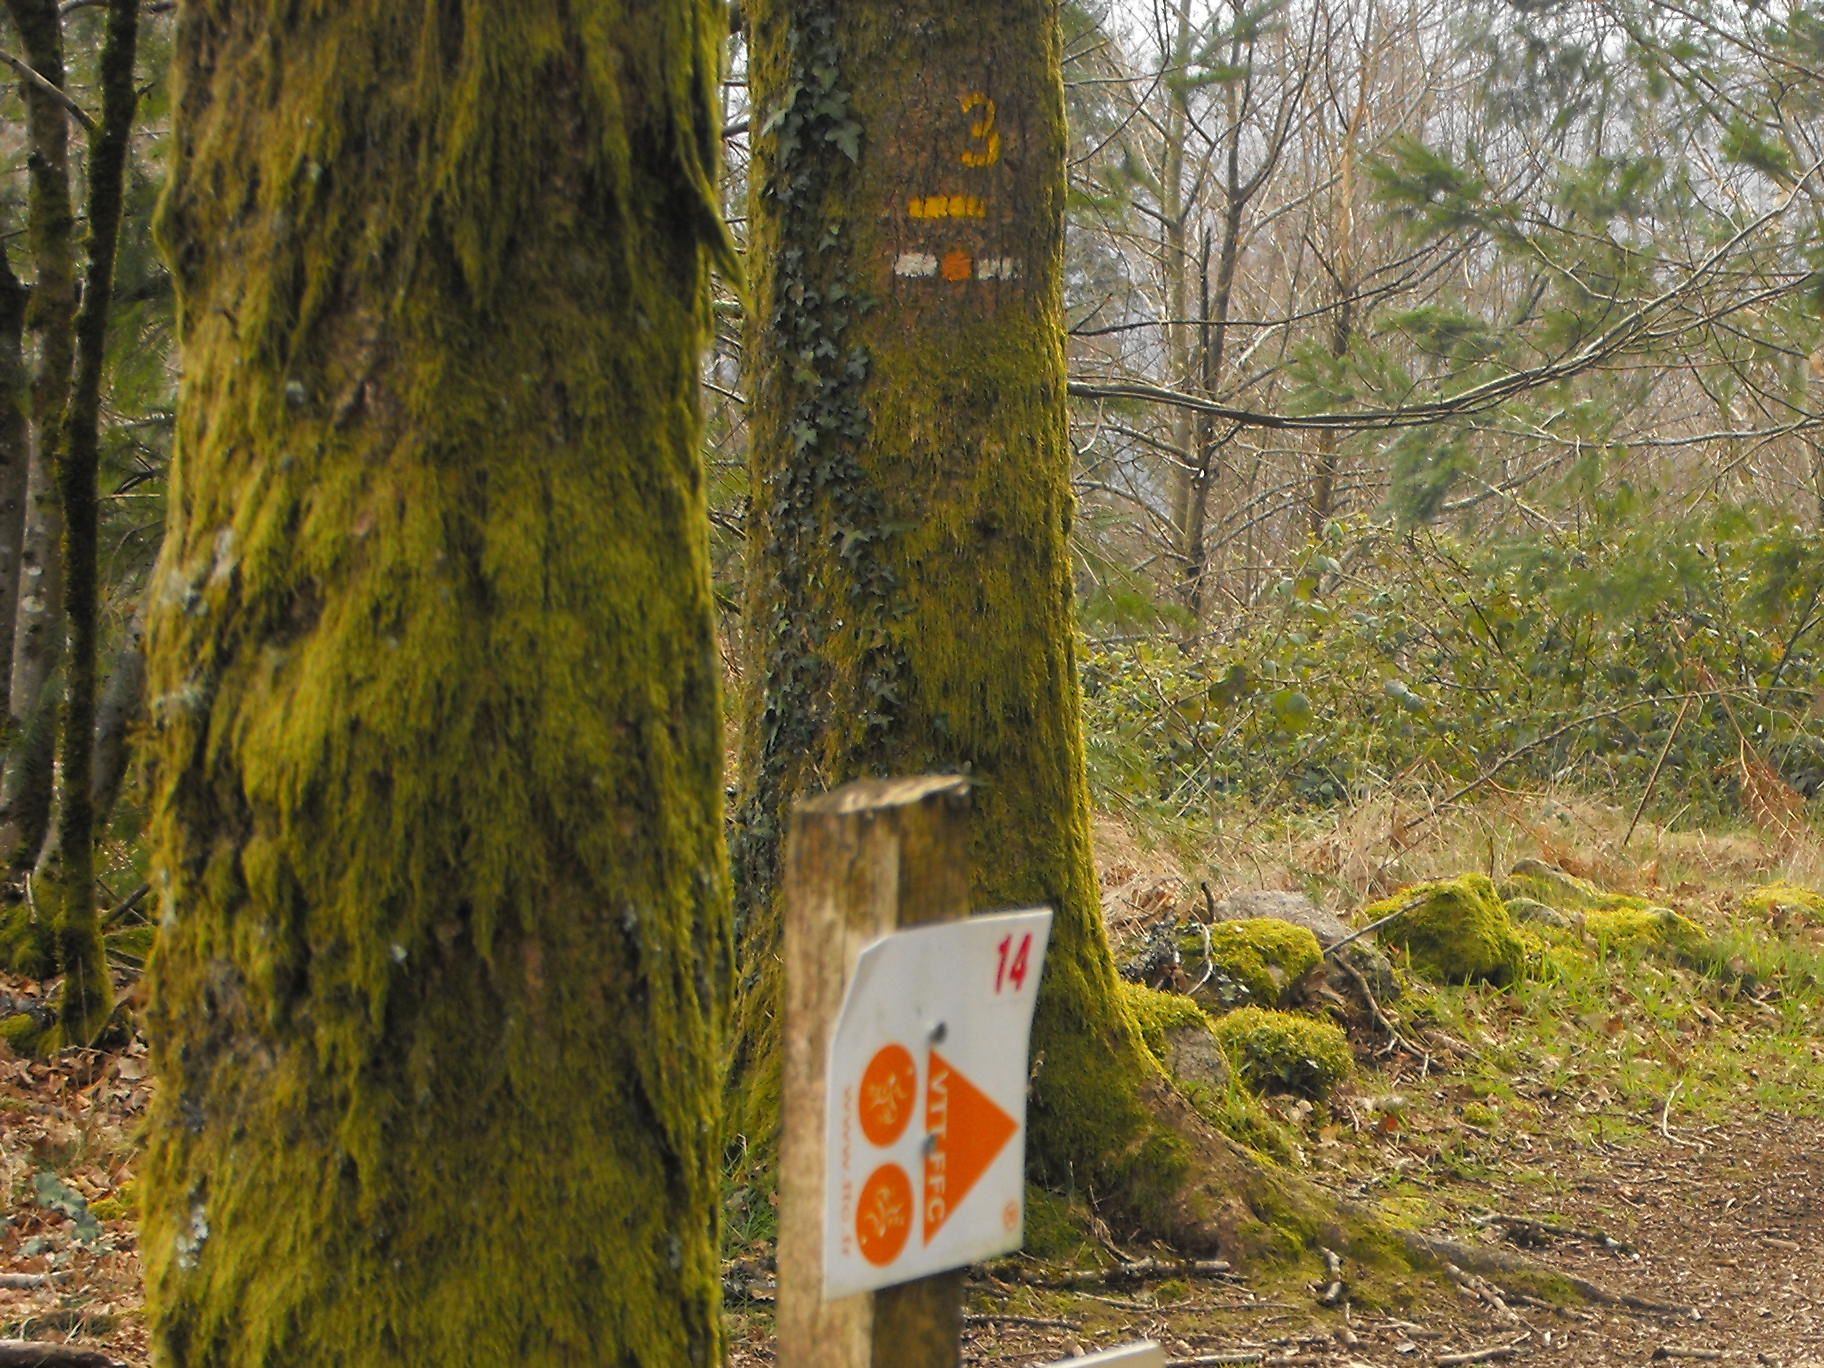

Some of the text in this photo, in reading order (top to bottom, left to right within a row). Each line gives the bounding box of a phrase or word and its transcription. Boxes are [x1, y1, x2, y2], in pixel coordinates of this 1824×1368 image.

[960, 90, 1001, 168] 3
[994, 932, 1034, 995] 14
[926, 1152, 947, 1223] FFC
